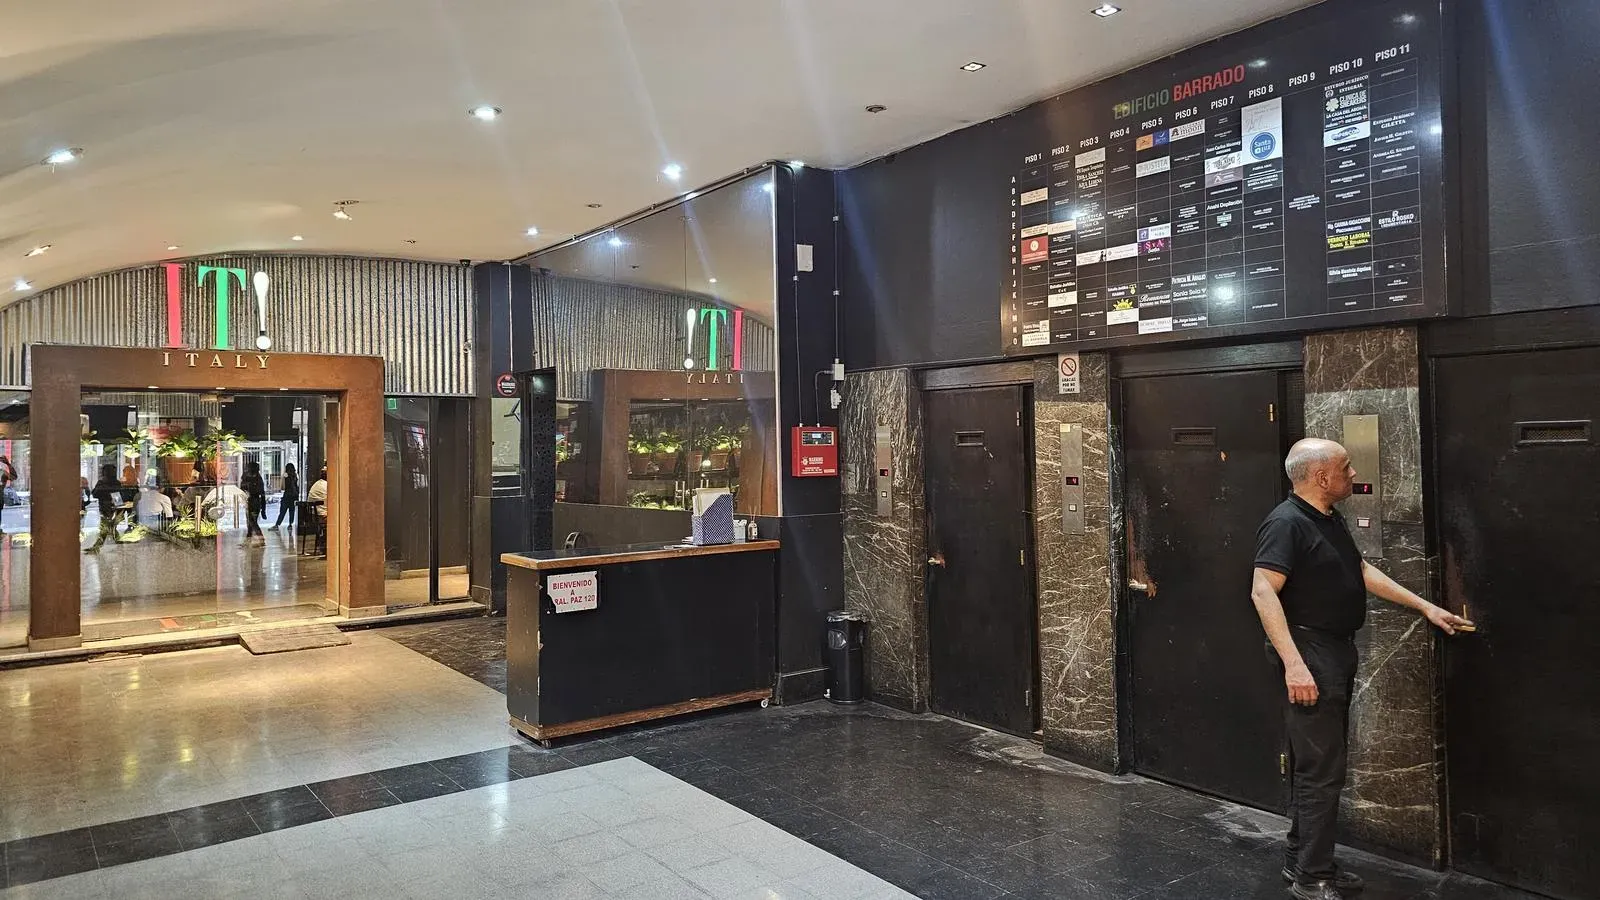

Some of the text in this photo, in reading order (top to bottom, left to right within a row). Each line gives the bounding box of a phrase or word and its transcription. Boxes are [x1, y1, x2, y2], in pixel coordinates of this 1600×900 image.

[1375, 44, 1410, 62] PISO 11
[1329, 58, 1363, 75] PISO 10
[1288, 72, 1316, 87] PISO 9
[1113, 64, 1245, 120] EDIFICIO BARRADO
[1248, 84, 1274, 99] PISO 8
[1211, 96, 1234, 109] PISO 7
[1175, 107, 1198, 120] PISO 6
[1141, 117, 1163, 130] PISO 5
[1381, 119, 1406, 129] GILETTA
[1110, 129, 1124, 139] PISO
[1080, 138, 1093, 147] PISO
[1254, 139, 1271, 148] Santa
[1052, 146, 1065, 156] PISO
[1025, 155, 1038, 164] PISO
[1378, 217, 1395, 225] ESTILO
[1349, 231, 1370, 240] LABORAL
[160, 263, 272, 352] IT!
[162, 352, 270, 369] ITALY
[552, 579, 592, 590] BIENVENIDO
[570, 596, 583, 604] PAZ
[584, 594, 596, 602] 120
